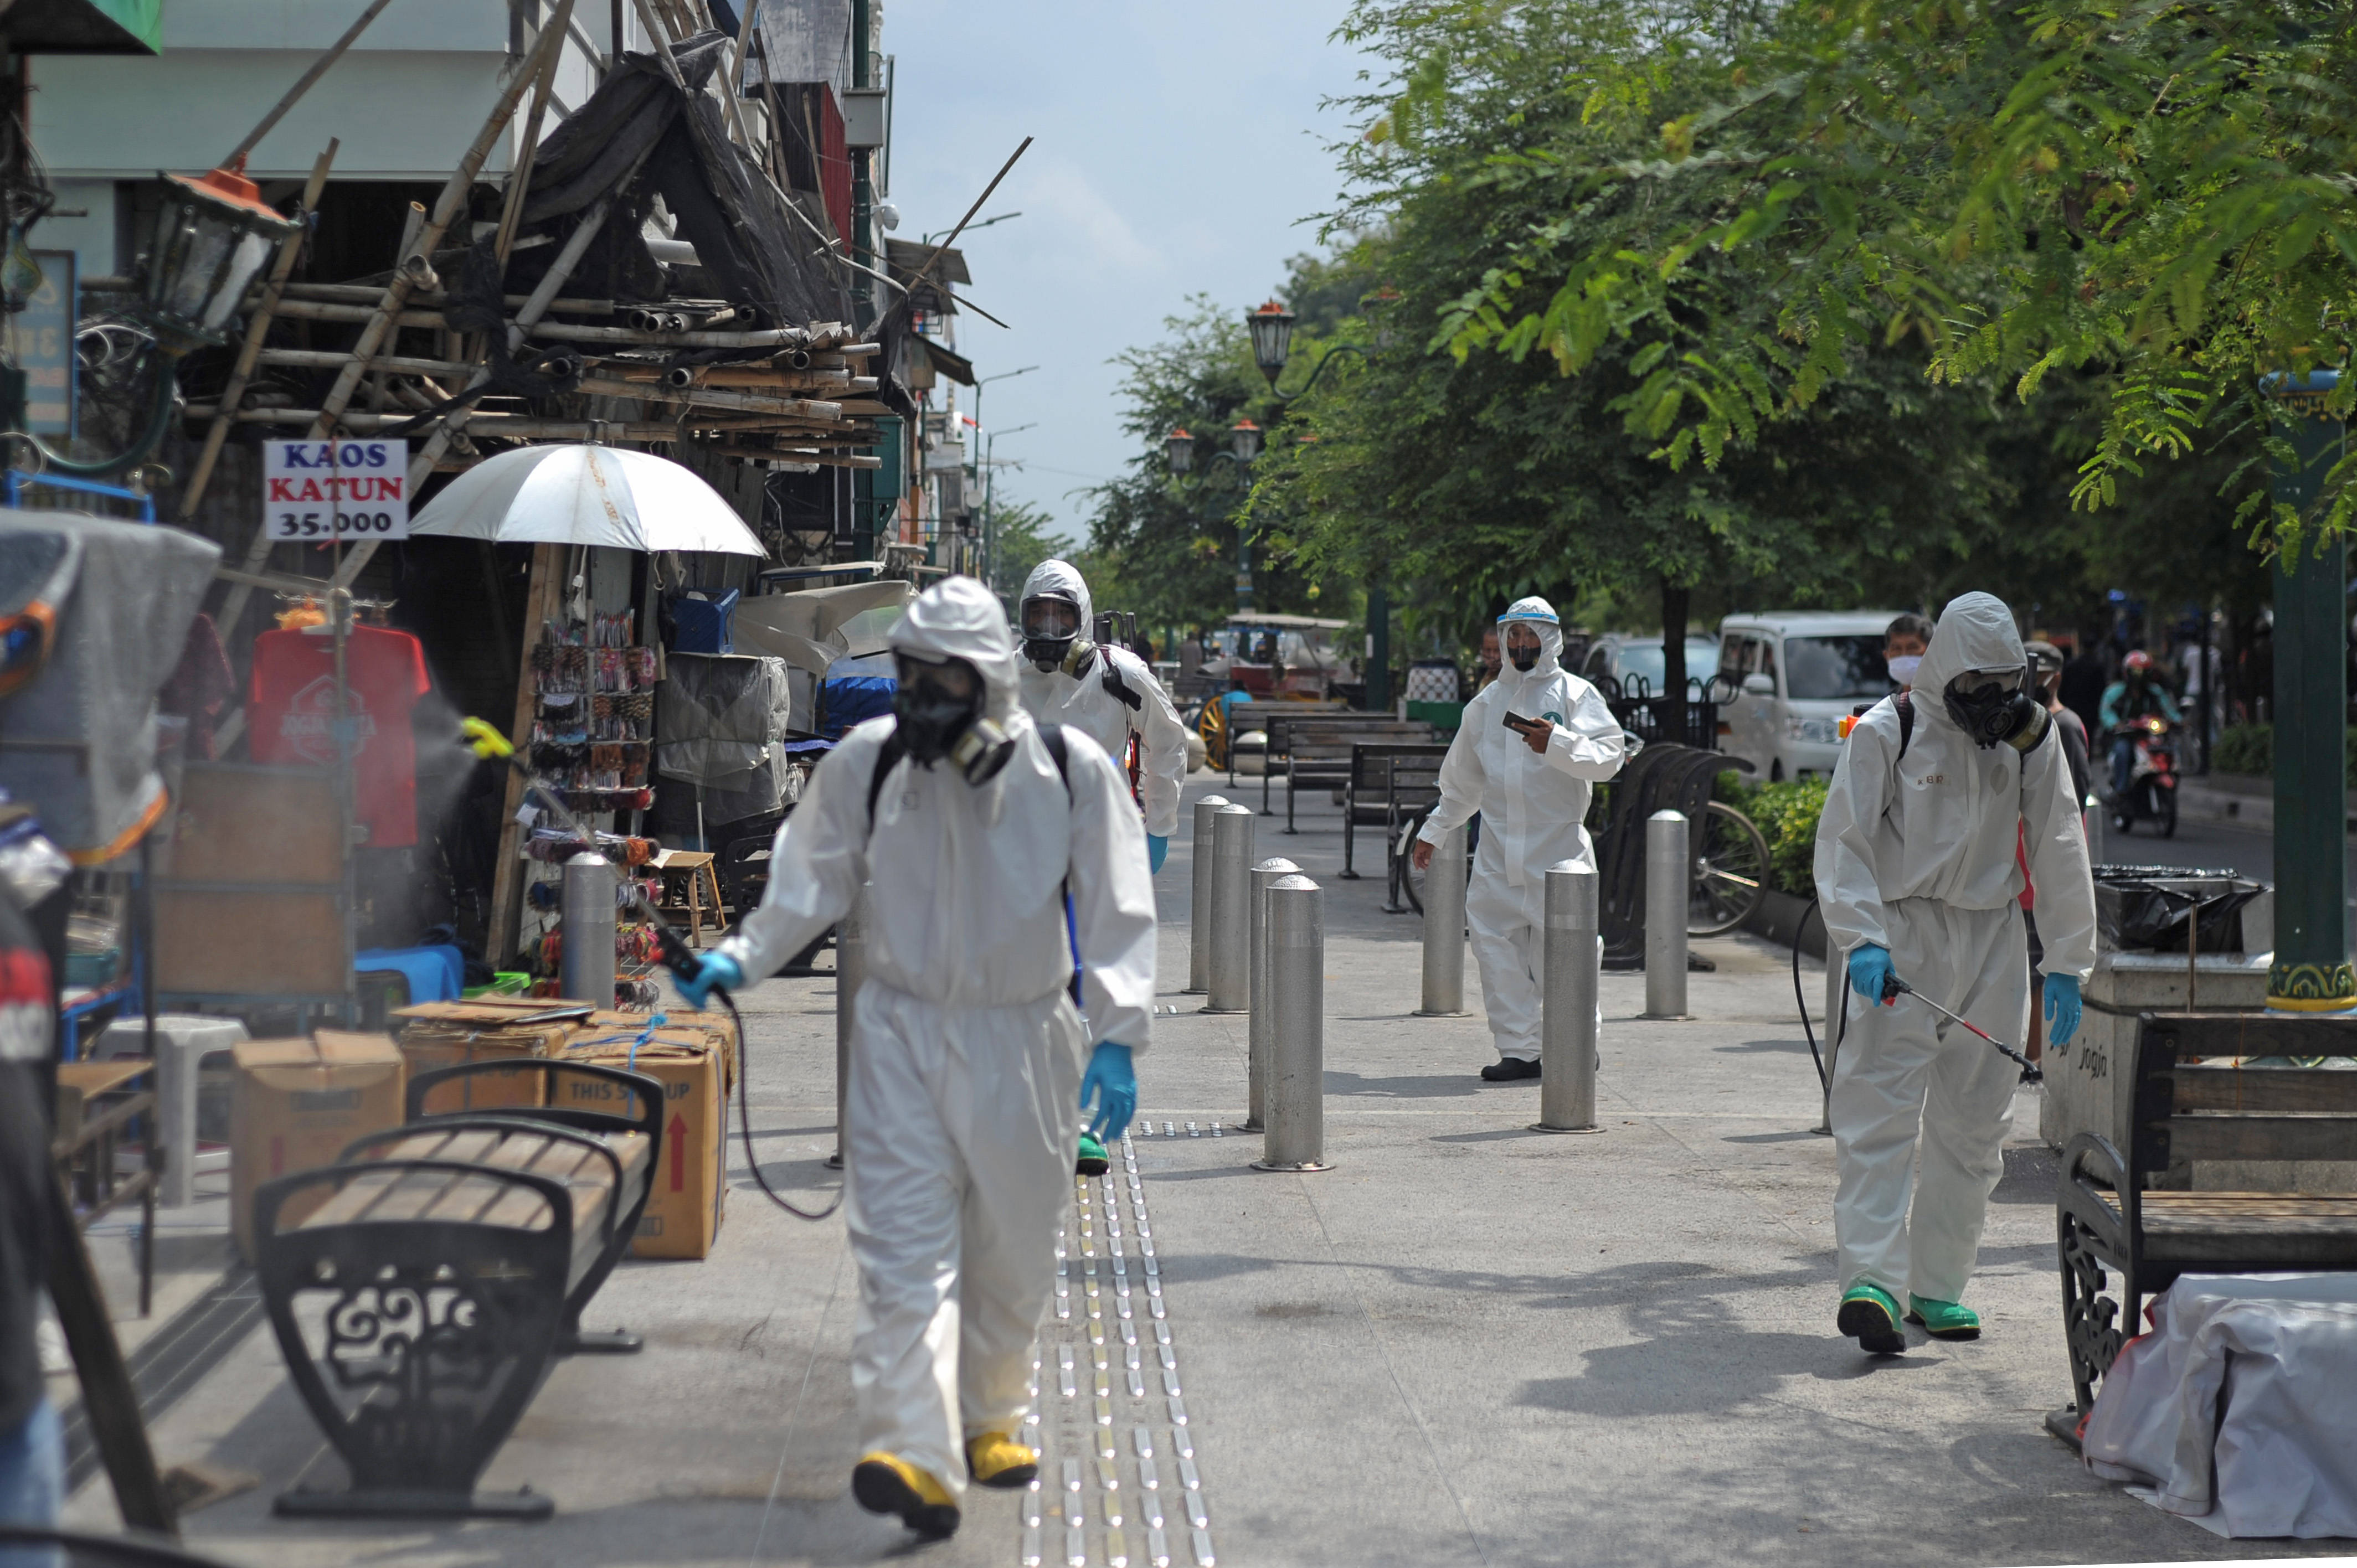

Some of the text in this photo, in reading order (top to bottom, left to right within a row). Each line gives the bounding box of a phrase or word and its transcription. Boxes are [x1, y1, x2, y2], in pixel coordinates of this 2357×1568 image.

[283, 443, 387, 468] KAOS
[267, 477, 403, 502] KATUN
[279, 512, 392, 537] 35.000
[570, 1082, 612, 1101] THIS
[665, 1082, 690, 1100] UP
